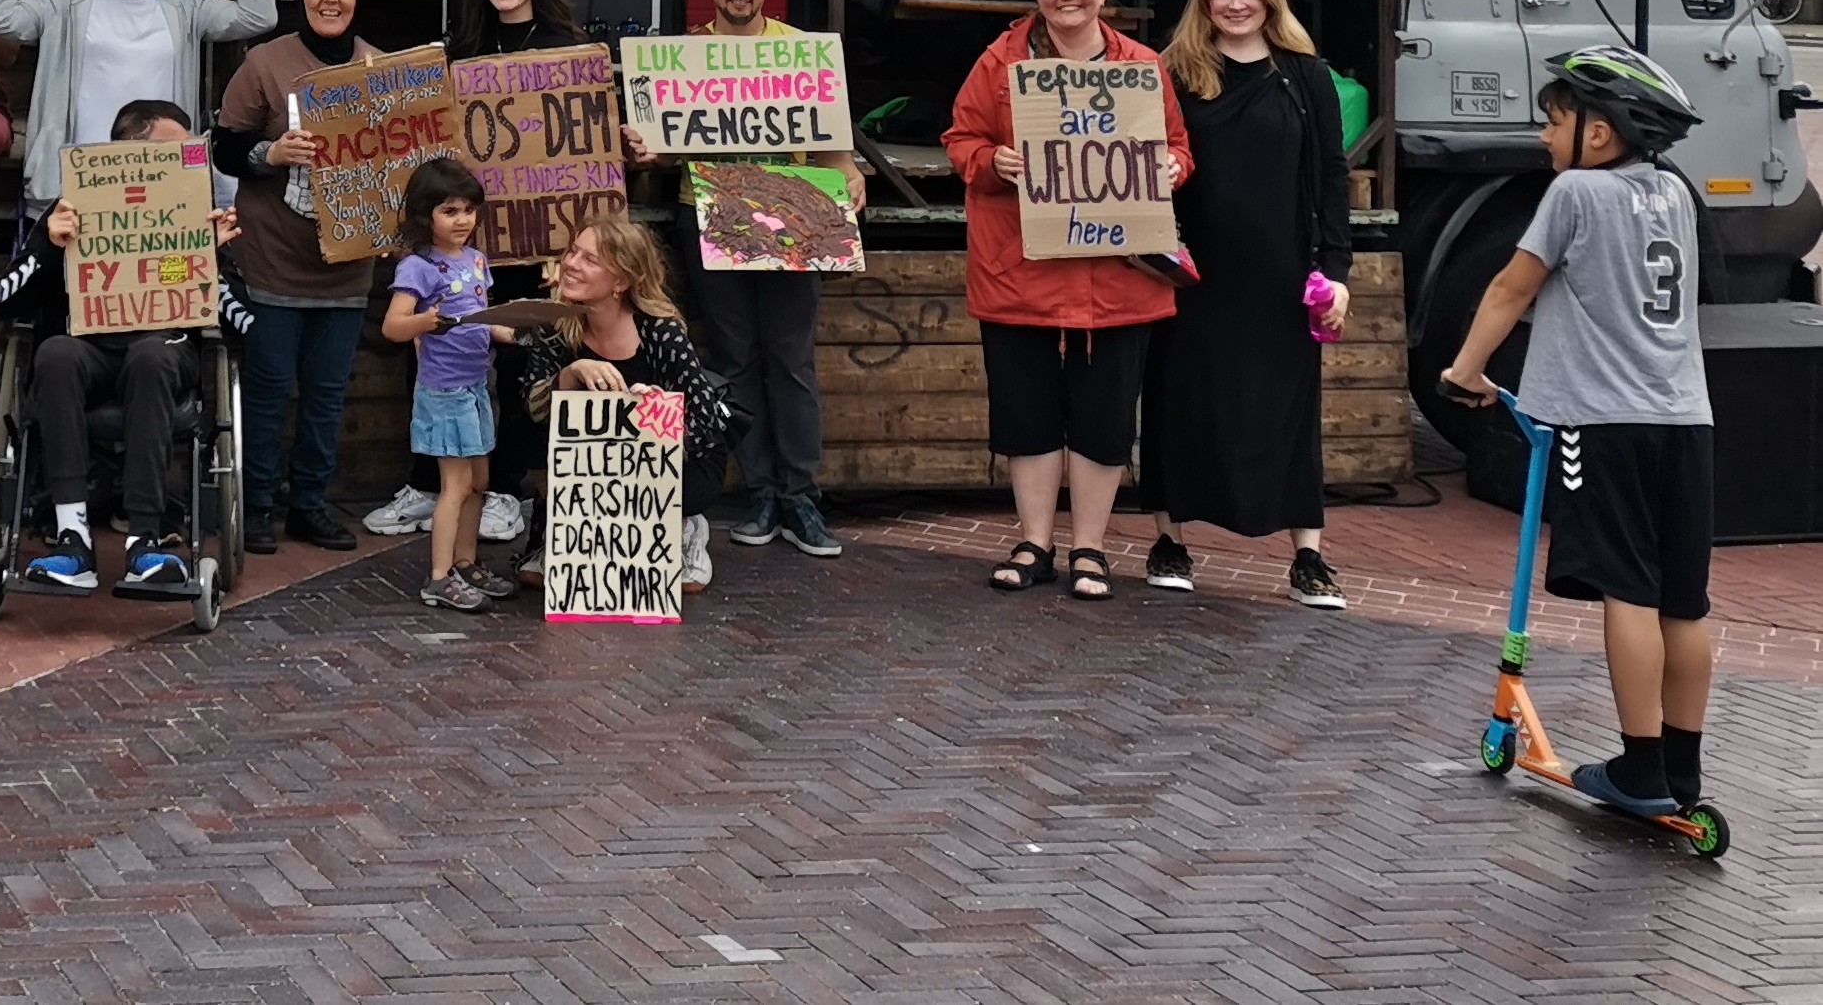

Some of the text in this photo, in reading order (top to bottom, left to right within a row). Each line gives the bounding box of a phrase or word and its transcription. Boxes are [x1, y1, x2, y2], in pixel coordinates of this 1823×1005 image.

[457, 53, 613, 94] DER FINDES IKKE
[637, 39, 835, 72] LUK ELLEBÆK
[1016, 63, 1158, 112] refugees
[309, 108, 454, 169] RACISME
[661, 105, 833, 146] FÆNGSEL
[1060, 109, 1116, 135] are
[70, 147, 180, 169] Generation
[478, 159, 625, 195] ER FINDES KUN
[1022, 139, 1171, 204] WELCOME
[78, 226, 212, 258] UDRENSNING
[1067, 206, 1125, 245] here
[78, 260, 120, 293] FY
[1640, 238, 1686, 329] 3
[83, 282, 212, 327] HELVEDE!
[559, 399, 678, 440] LUK NU
[554, 441, 680, 480] ELLEBÆK
[647, 523, 673, 564] &
[548, 561, 682, 615] SJÆLSMARK
